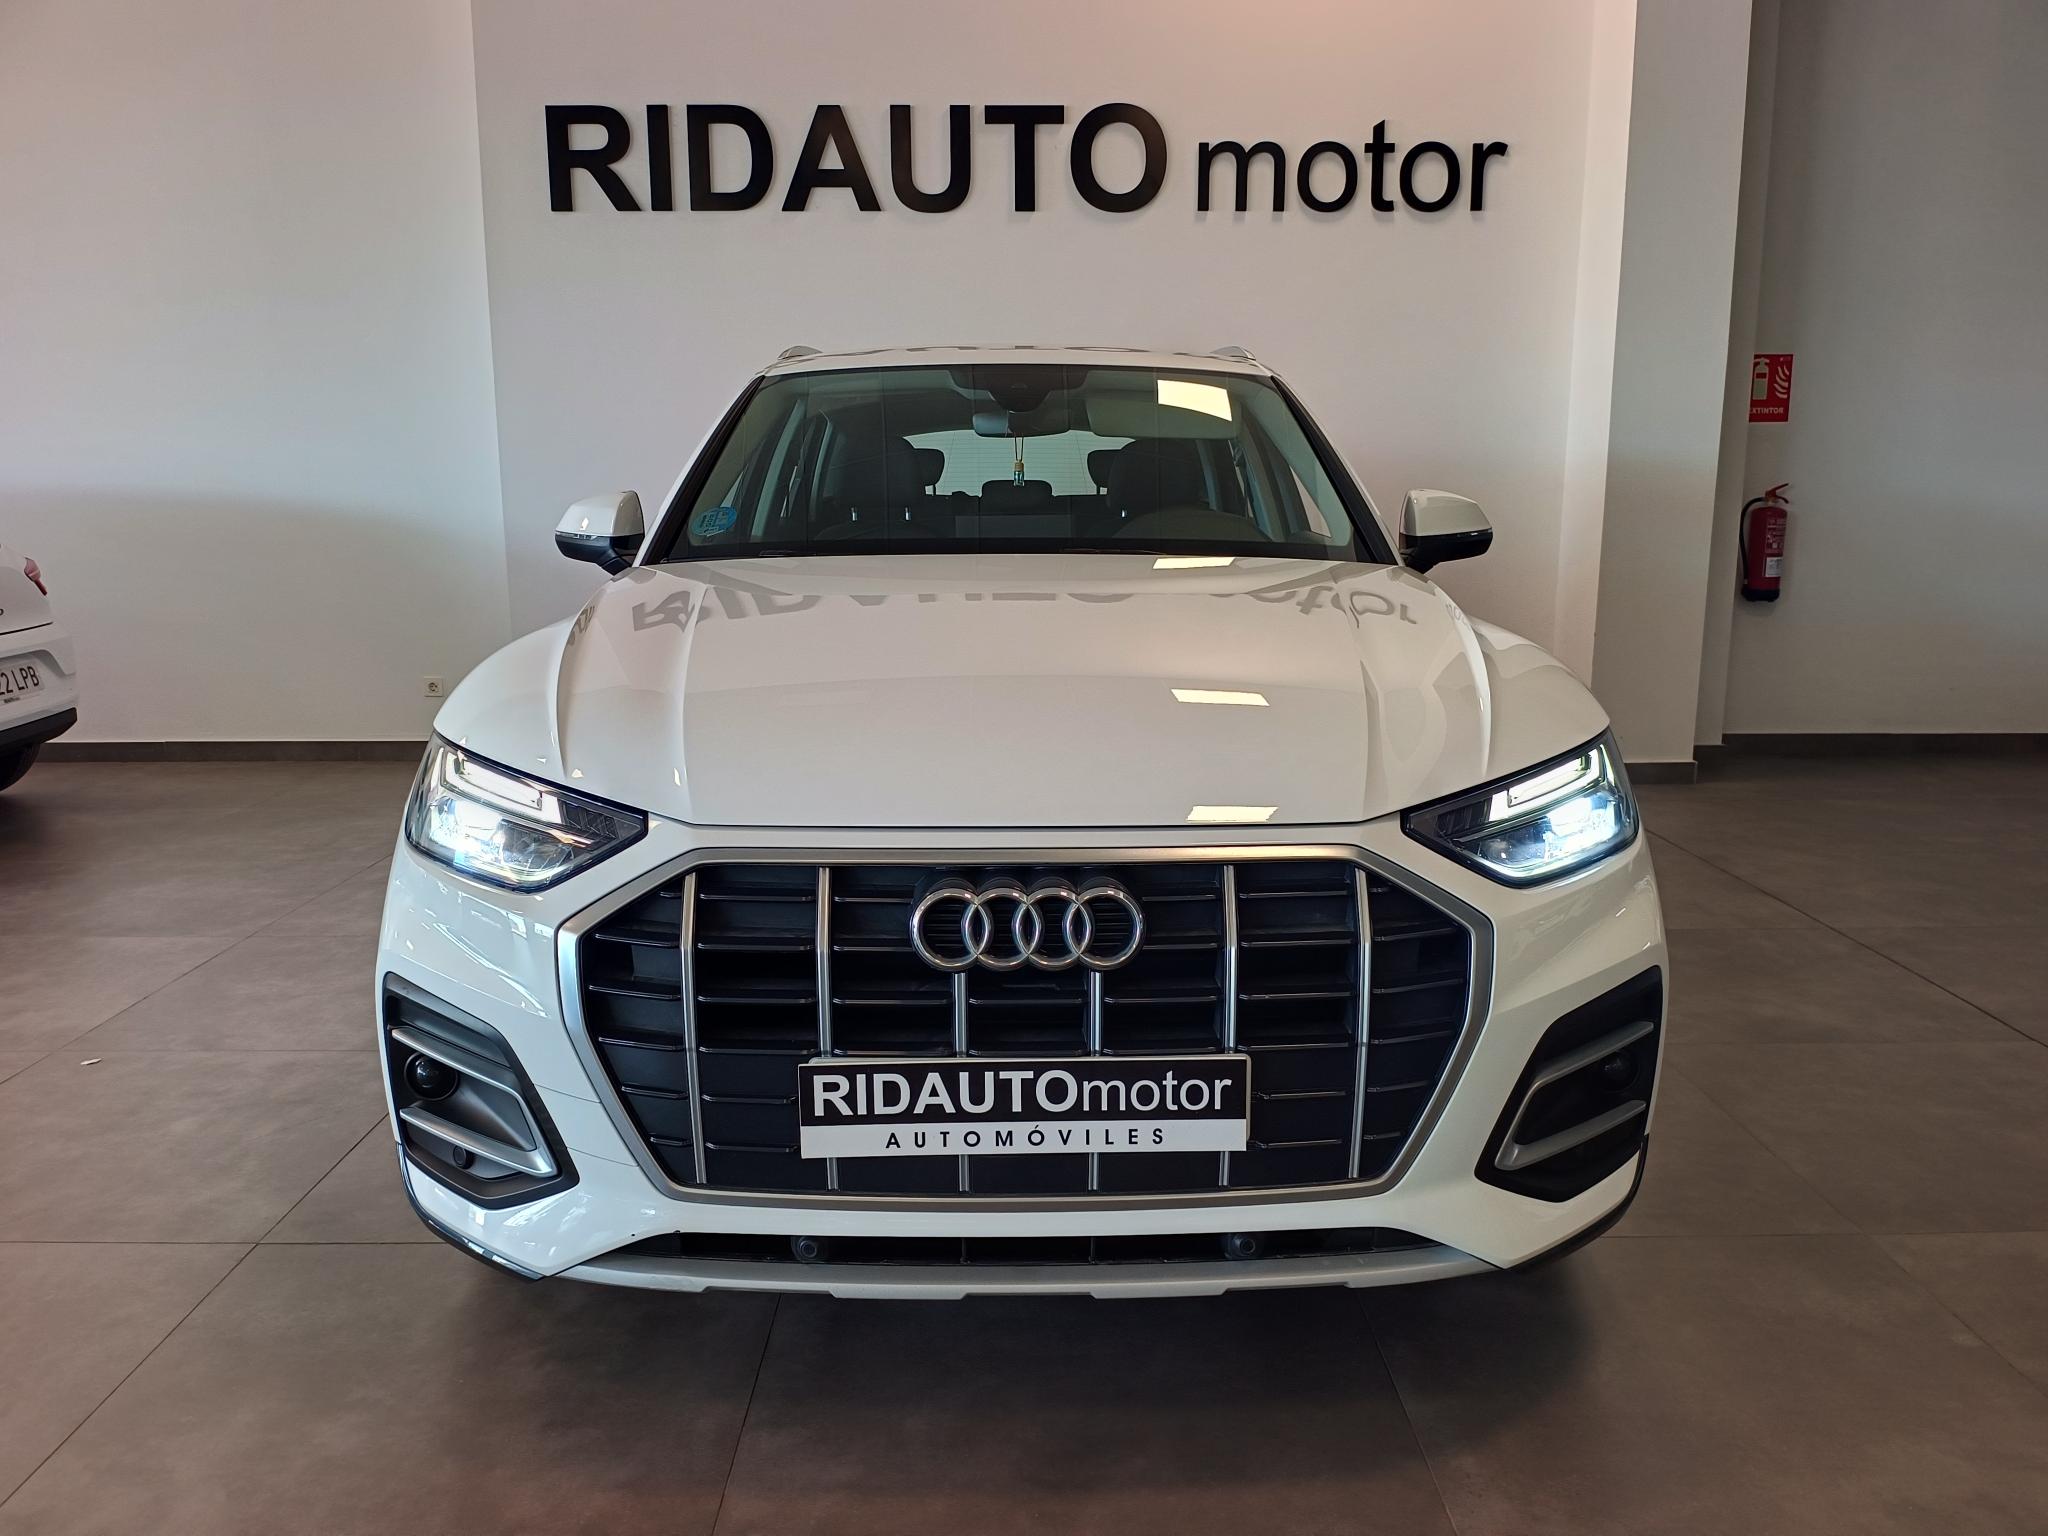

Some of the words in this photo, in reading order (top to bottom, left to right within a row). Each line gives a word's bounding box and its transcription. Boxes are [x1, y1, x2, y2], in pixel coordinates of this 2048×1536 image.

[545, 103, 1166, 213] RIDAUTO
[1197, 120, 1508, 213] motor
[11, 666, 40, 690] LPB
[885, 1125, 1164, 1149] AUTOMÓVILES
